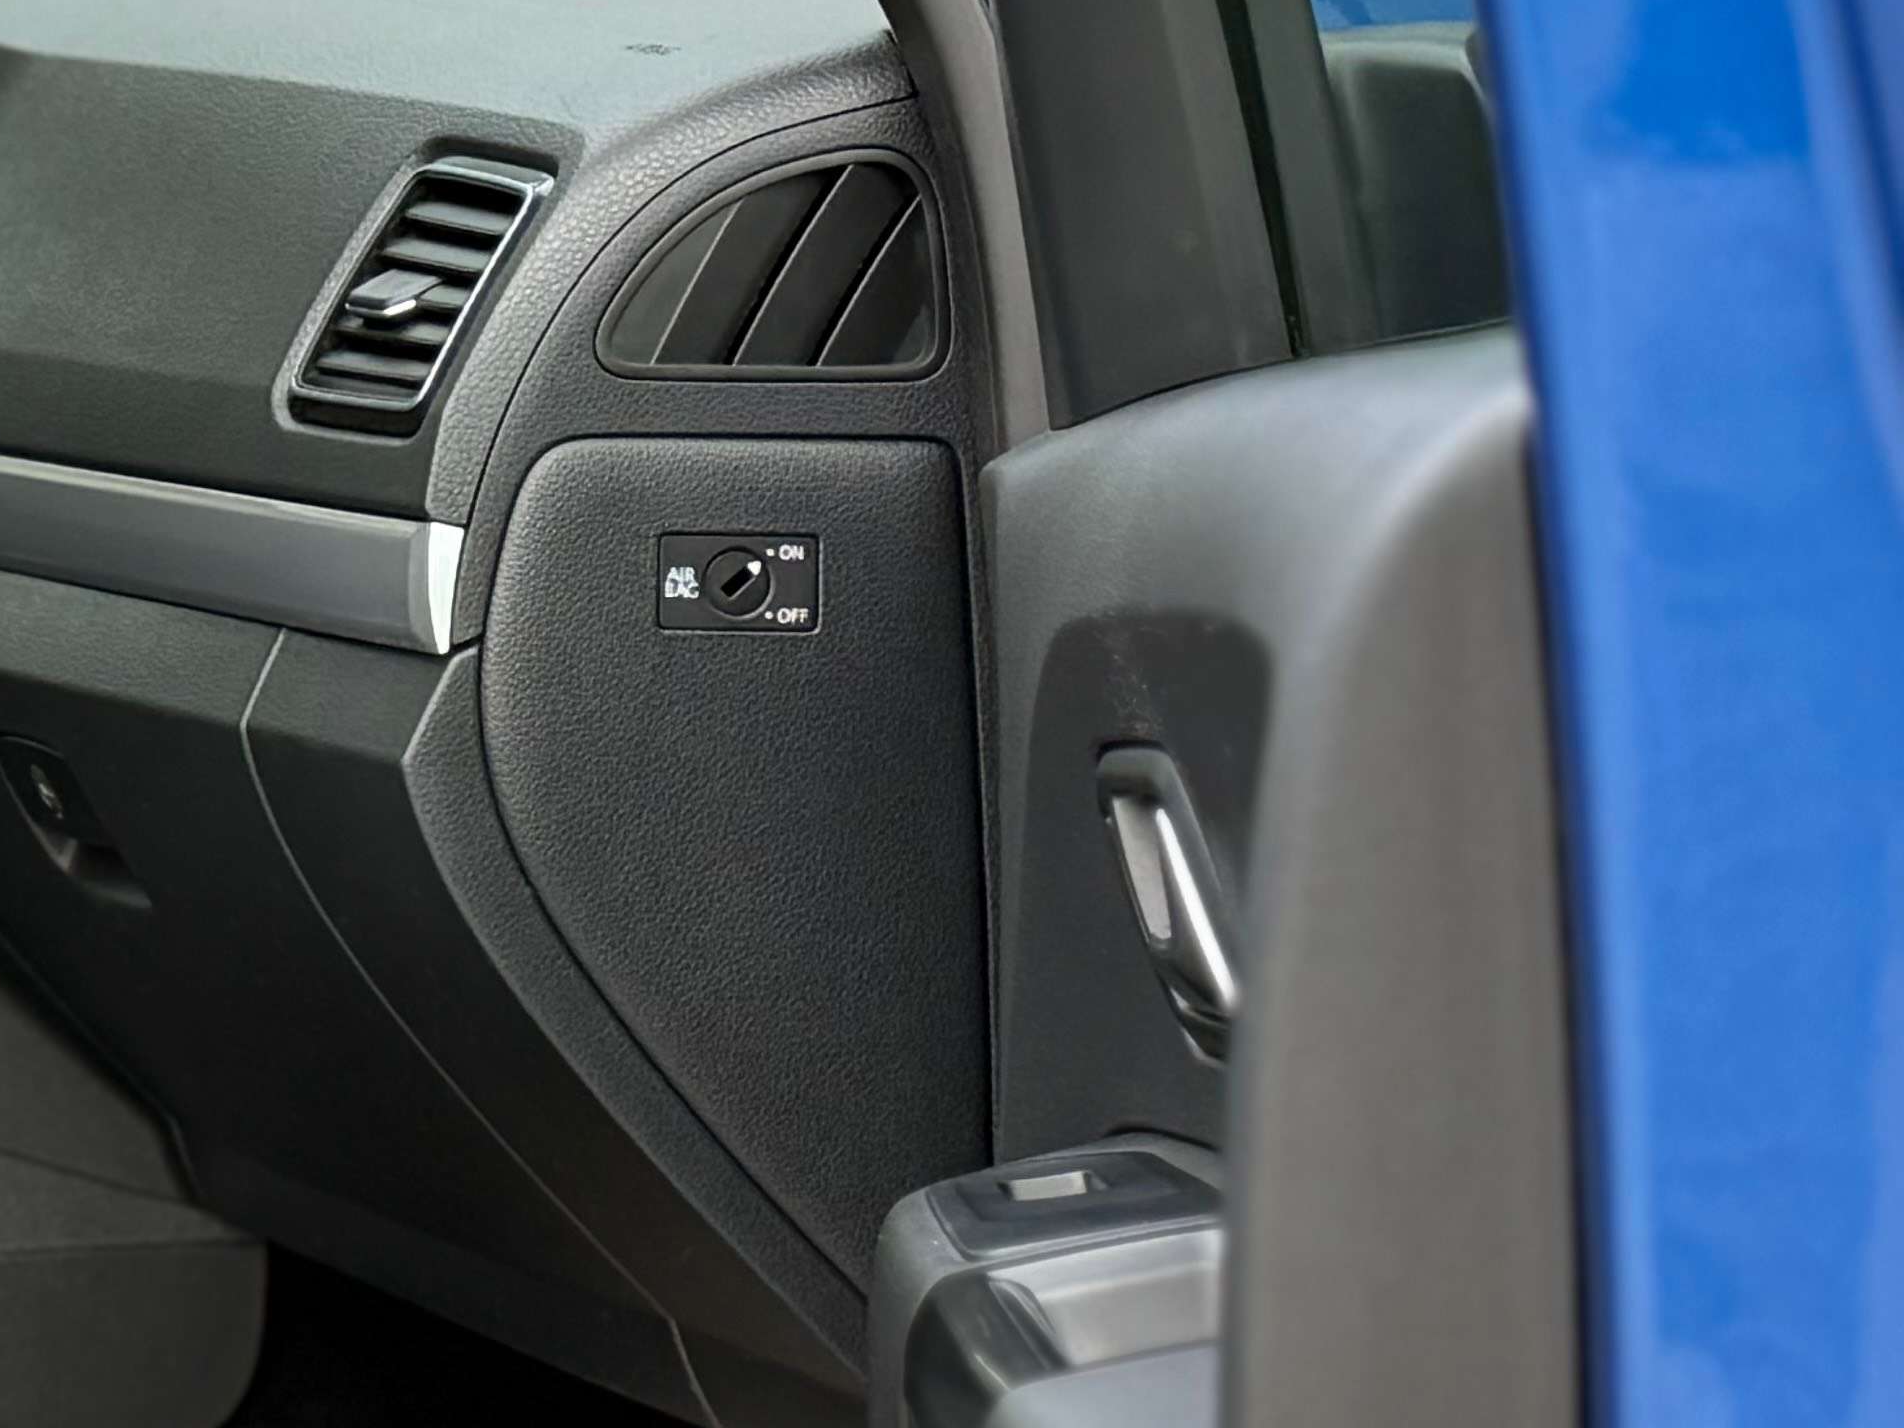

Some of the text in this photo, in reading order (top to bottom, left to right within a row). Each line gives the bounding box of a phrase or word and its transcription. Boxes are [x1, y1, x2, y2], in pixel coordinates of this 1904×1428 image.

[778, 545, 805, 561] ON
[667, 566, 696, 581] AIR
[776, 607, 809, 625] OFF
